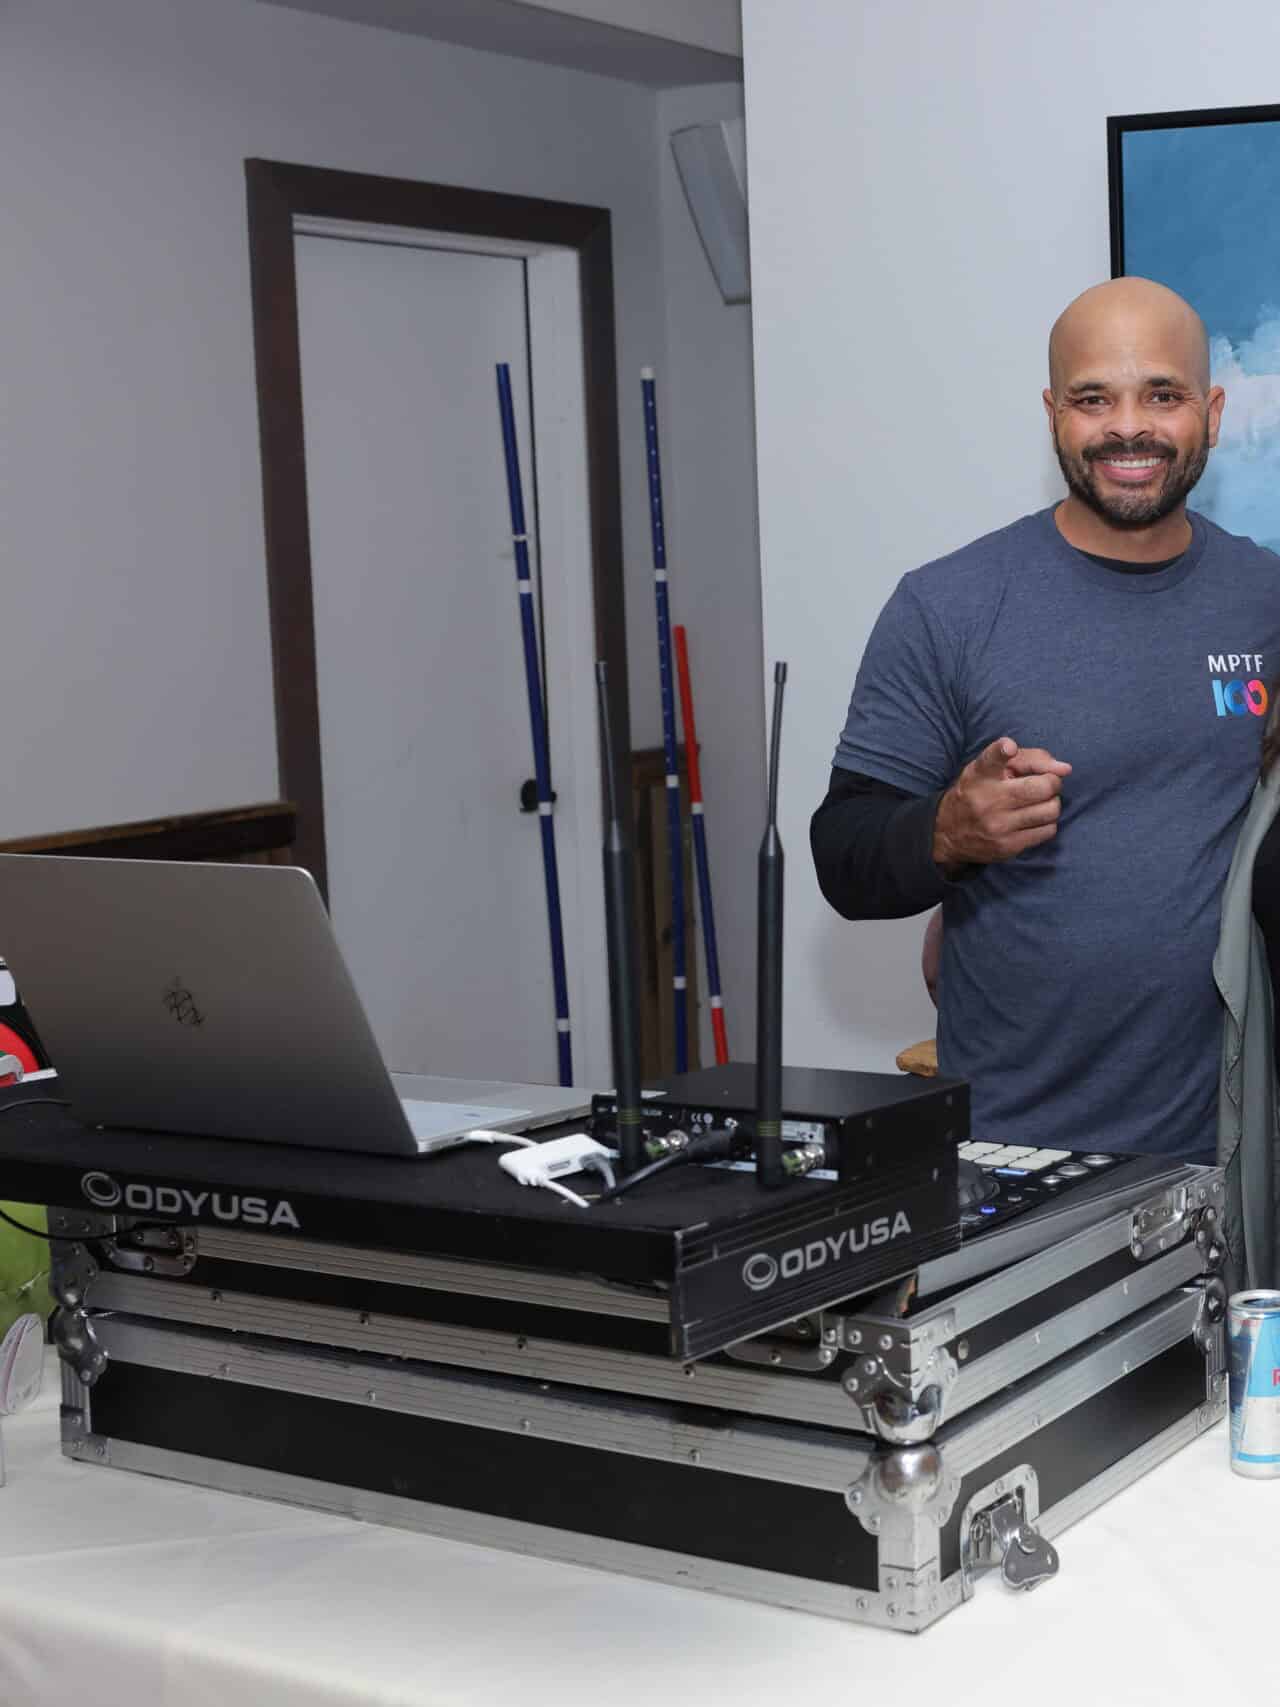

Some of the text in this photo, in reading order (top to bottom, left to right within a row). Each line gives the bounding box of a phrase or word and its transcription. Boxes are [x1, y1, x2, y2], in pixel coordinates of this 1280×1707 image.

[1207, 653, 1264, 673] MPTF
[125, 1183, 301, 1229] ODYUSA
[780, 1210, 912, 1279] ODYUSA
